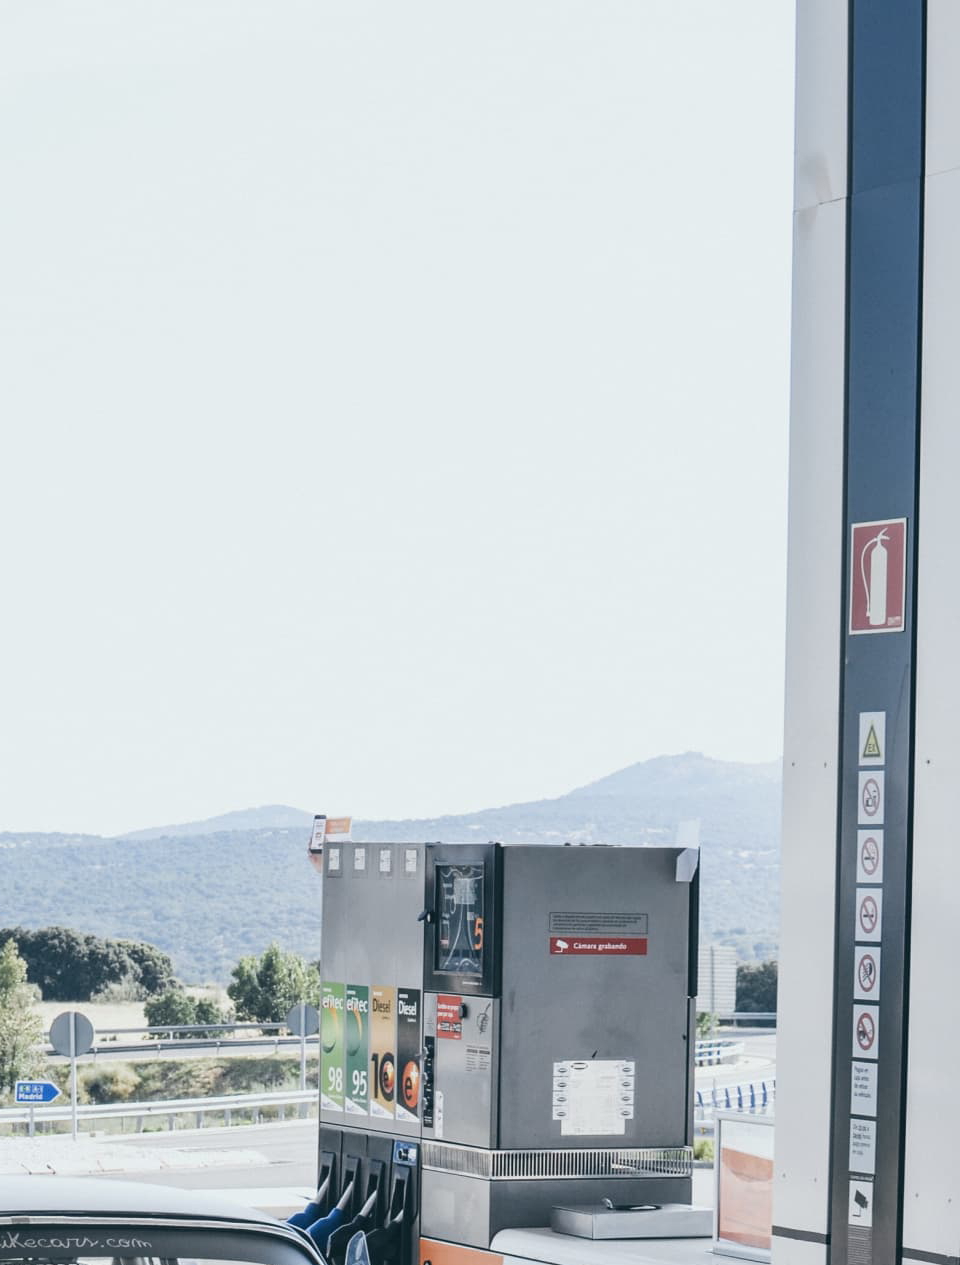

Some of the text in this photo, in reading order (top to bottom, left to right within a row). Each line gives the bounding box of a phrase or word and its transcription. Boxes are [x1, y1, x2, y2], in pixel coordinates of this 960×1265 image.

[598, 942, 627, 951] grabando
[372, 998, 391, 1013] Diesel
[398, 1000, 417, 1016] Diesel
[328, 1066, 343, 1093] 98
[352, 1069, 367, 1096] 95
